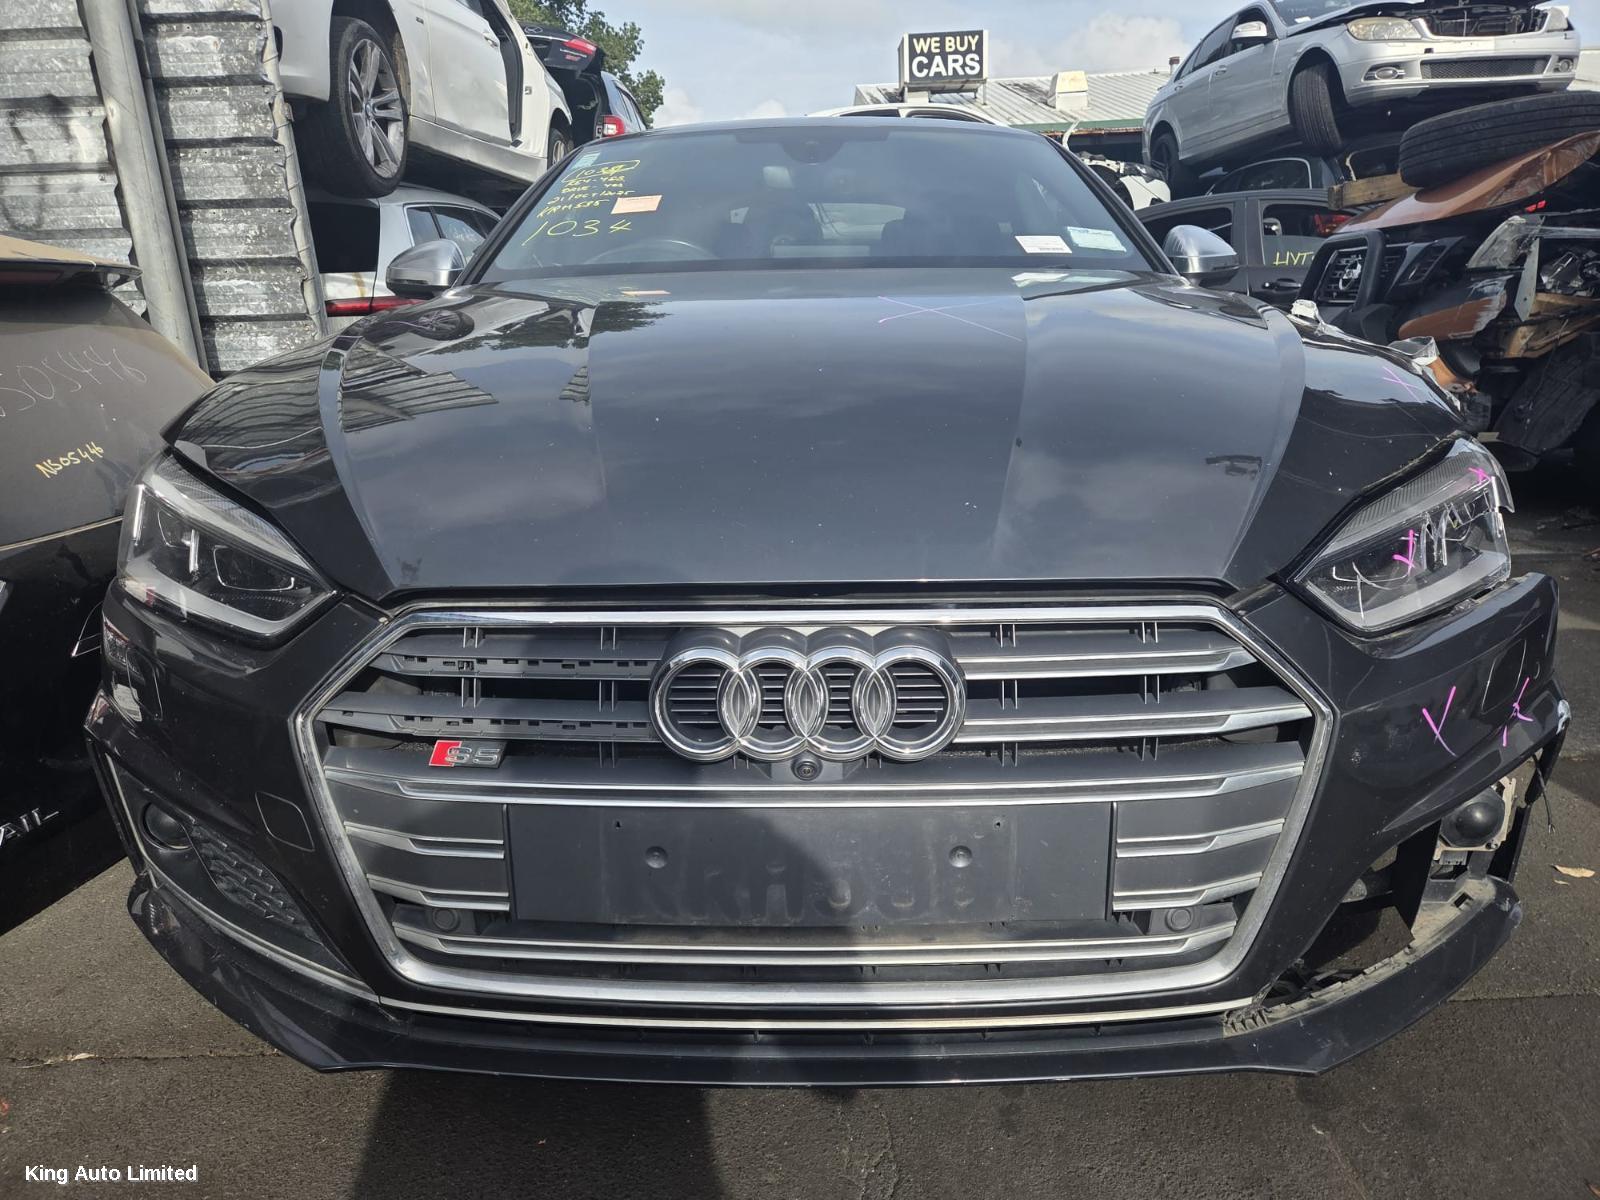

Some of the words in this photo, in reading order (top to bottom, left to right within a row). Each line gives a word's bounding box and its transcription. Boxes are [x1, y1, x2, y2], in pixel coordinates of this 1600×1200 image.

[913, 37, 940, 54] WE
[945, 35, 979, 52] BUY
[912, 53, 980, 78] CARS
[521, 219, 632, 247] 1034
